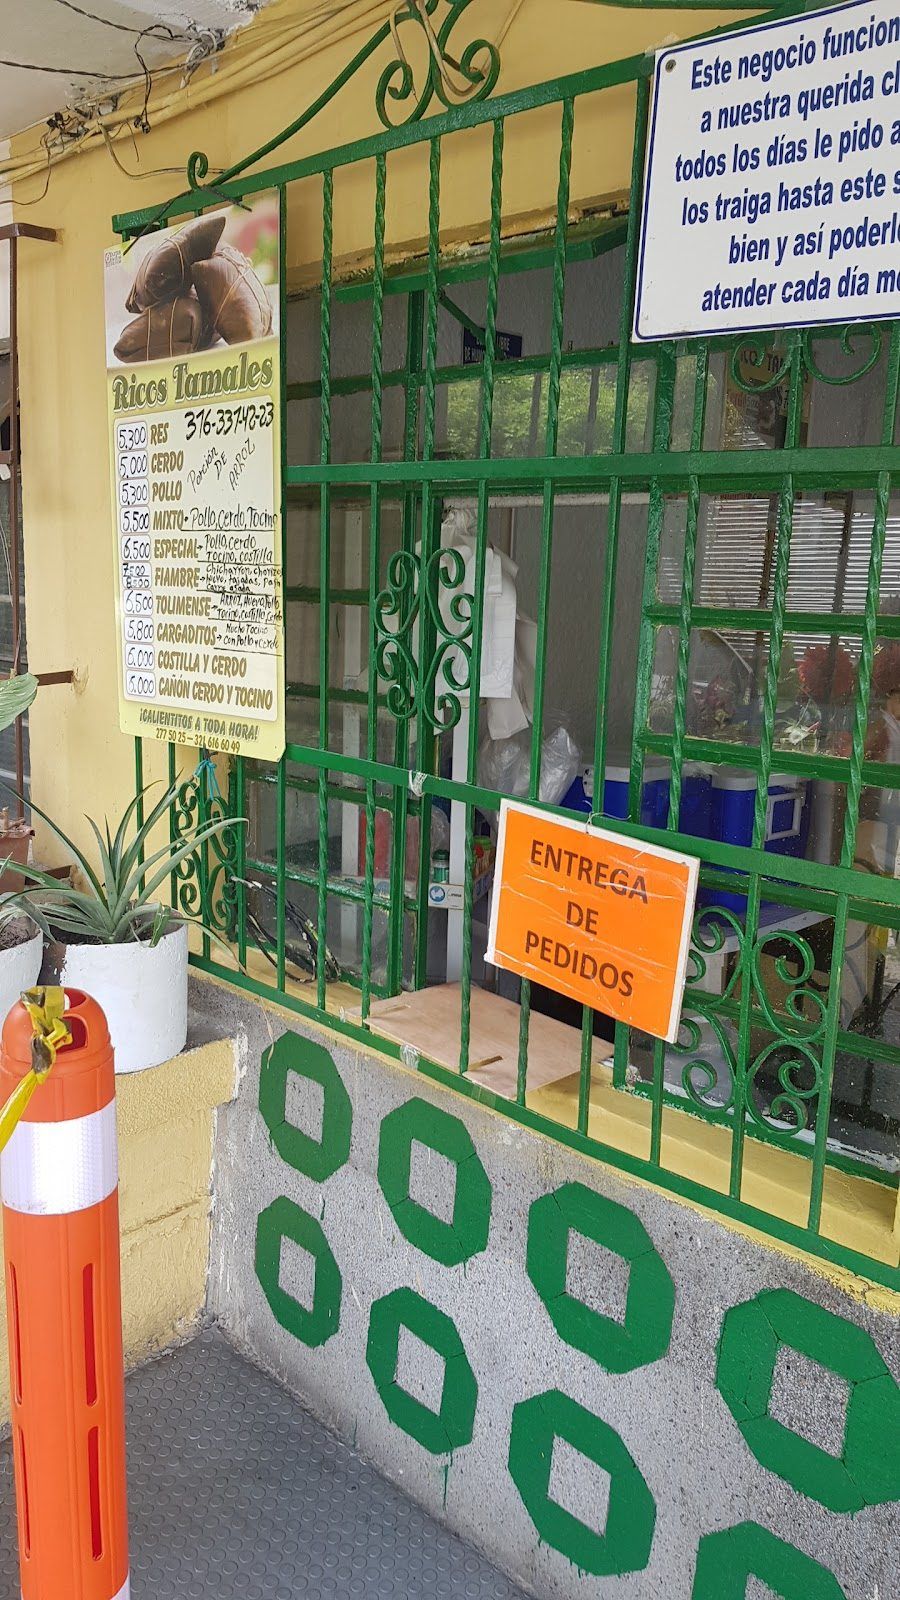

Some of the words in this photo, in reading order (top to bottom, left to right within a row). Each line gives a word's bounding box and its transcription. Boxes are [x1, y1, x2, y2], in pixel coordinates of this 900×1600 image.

[691, 55, 732, 91] Este
[738, 34, 816, 83] negocio
[701, 110, 712, 134] a
[718, 90, 790, 131] nuestra
[797, 69, 874, 121] querida
[675, 150, 726, 182] todos
[732, 143, 760, 173] los
[766, 134, 808, 167] días
[814, 127, 832, 159] le
[838, 118, 883, 162] pido
[681, 197, 709, 226] los
[716, 188, 771, 224] traiga
[777, 177, 833, 213] hasta
[841, 168, 886, 203] este
[729, 234, 769, 265] bien
[774, 238, 788, 266] y
[793, 223, 824, 257] así
[702, 278, 776, 312] atender
[782, 271, 830, 303] cada
[838, 265, 869, 297] día
[112, 373, 167, 412] Ricos
[173, 352, 274, 404] Tamales
[119, 427, 147, 450] 5.300
[150, 422, 170, 446] RES
[120, 454, 148, 478] 5.000
[151, 450, 184, 474] CERDO
[214, 451, 227, 480] DE
[121, 482, 148, 505] 5.300
[152, 480, 182, 502] POLLO
[153, 509, 183, 530] MIXTO
[154, 537, 199, 560] ESPECIAL
[154, 567, 200, 590] FIAMBRE
[155, 595, 212, 617] TOLIMENSE
[128, 620, 154, 640] 5.800
[156, 622, 218, 646] CARGADITOS
[157, 649, 200, 673] COSTILLA
[203, 653, 209, 674] Y
[211, 655, 247, 678] CERDO
[158, 674, 190, 699] CAÑÓN
[192, 680, 224, 704] CERDO
[227, 686, 233, 704] Y
[234, 686, 273, 711] TOCINO
[139, 707, 193, 730] ¡CALIENTITOS
[194, 716, 201, 730] A
[203, 717, 226, 736] TODA
[229, 721, 259, 741] HORA!
[156, 727, 167, 740] 277
[168, 729, 177, 741] 50
[178, 731, 186, 743] 25
[207, 736, 220, 749] 616
[220, 739, 230, 751] 60
[231, 741, 241, 754] 49
[529, 839, 649, 905] ENTREGA
[566, 900, 599, 936] DE
[525, 930, 635, 998] PEDIDOS
